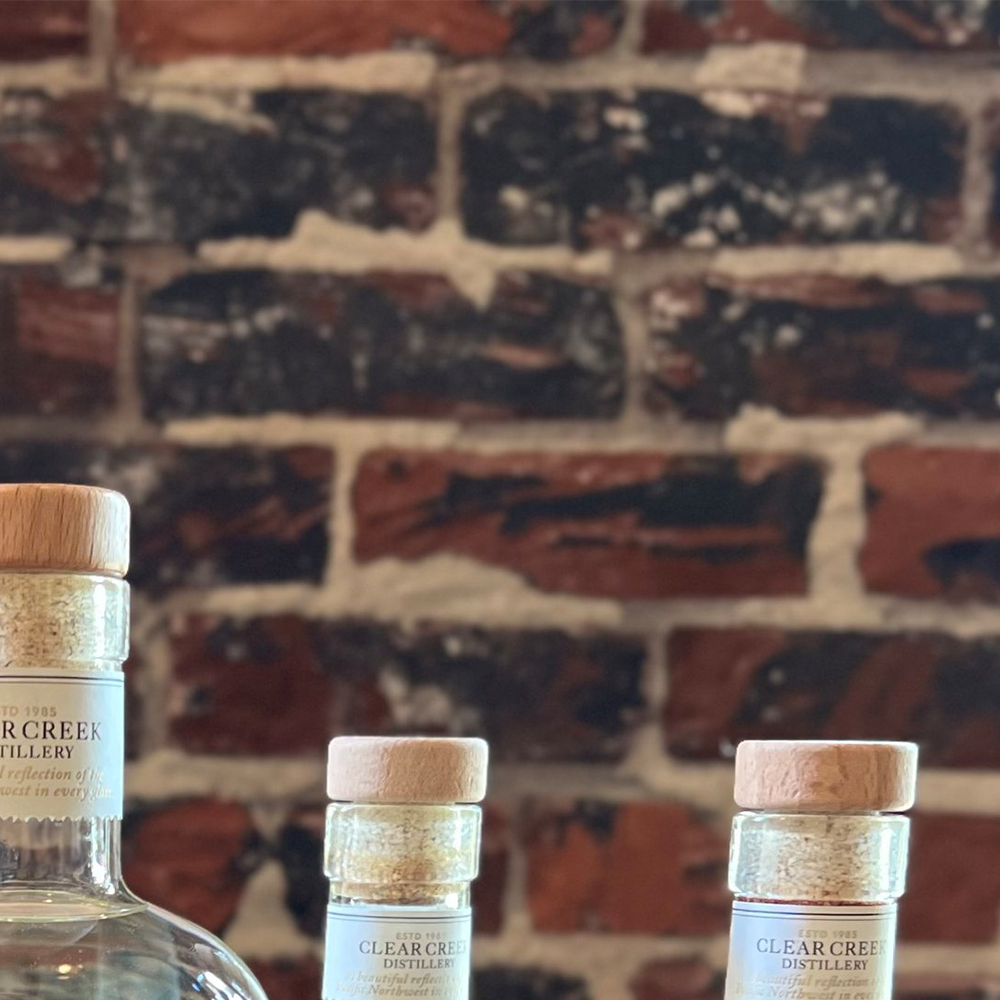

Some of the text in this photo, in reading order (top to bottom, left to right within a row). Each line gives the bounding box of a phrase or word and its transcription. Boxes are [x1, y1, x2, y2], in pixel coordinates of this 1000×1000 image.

[21, 720, 102, 741] CREEK
[7, 766, 72, 784] reflection
[35, 784, 49, 797] in
[359, 940, 422, 956] CLEAR
[756, 938, 825, 956] CLEAR
[383, 958, 456, 969] DISTILLERY
[782, 958, 868, 971] DISTILLERY
